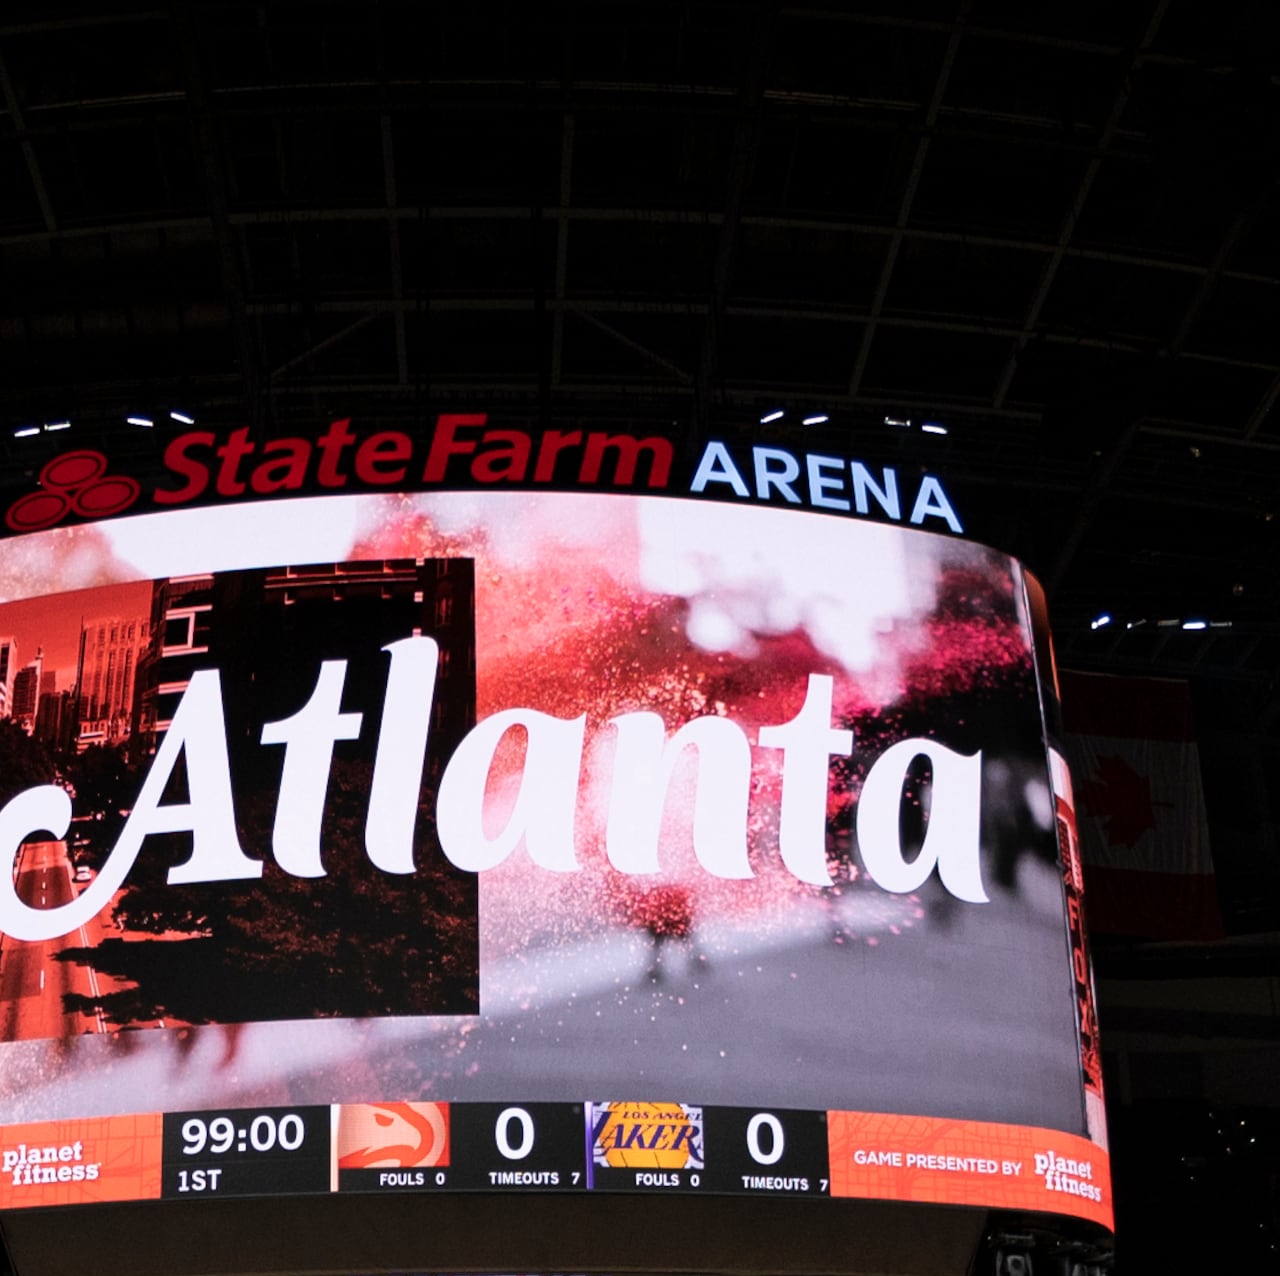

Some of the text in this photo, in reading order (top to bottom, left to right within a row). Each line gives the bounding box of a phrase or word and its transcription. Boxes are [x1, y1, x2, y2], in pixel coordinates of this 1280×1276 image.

[690, 441, 963, 534] ARENA
[181, 1114, 305, 1154] 99:00
[495, 1107, 535, 1159] 0
[746, 1113, 785, 1165] 0
[1, 1140, 83, 1173] planet
[854, 1151, 1022, 1175] GAME PRESENTED BY
[1034, 1151, 1091, 1180] planet
[11, 1162, 100, 1186] fitness
[177, 1170, 222, 1192] 1ST
[379, 1173, 445, 1186] FOULS 0
[489, 1173, 581, 1186] TIMEOUTS 7
[635, 1173, 700, 1187] FOULS 0
[741, 1176, 829, 1192] TIMEOUTS 7
[1045, 1171, 1102, 1201] fitness
